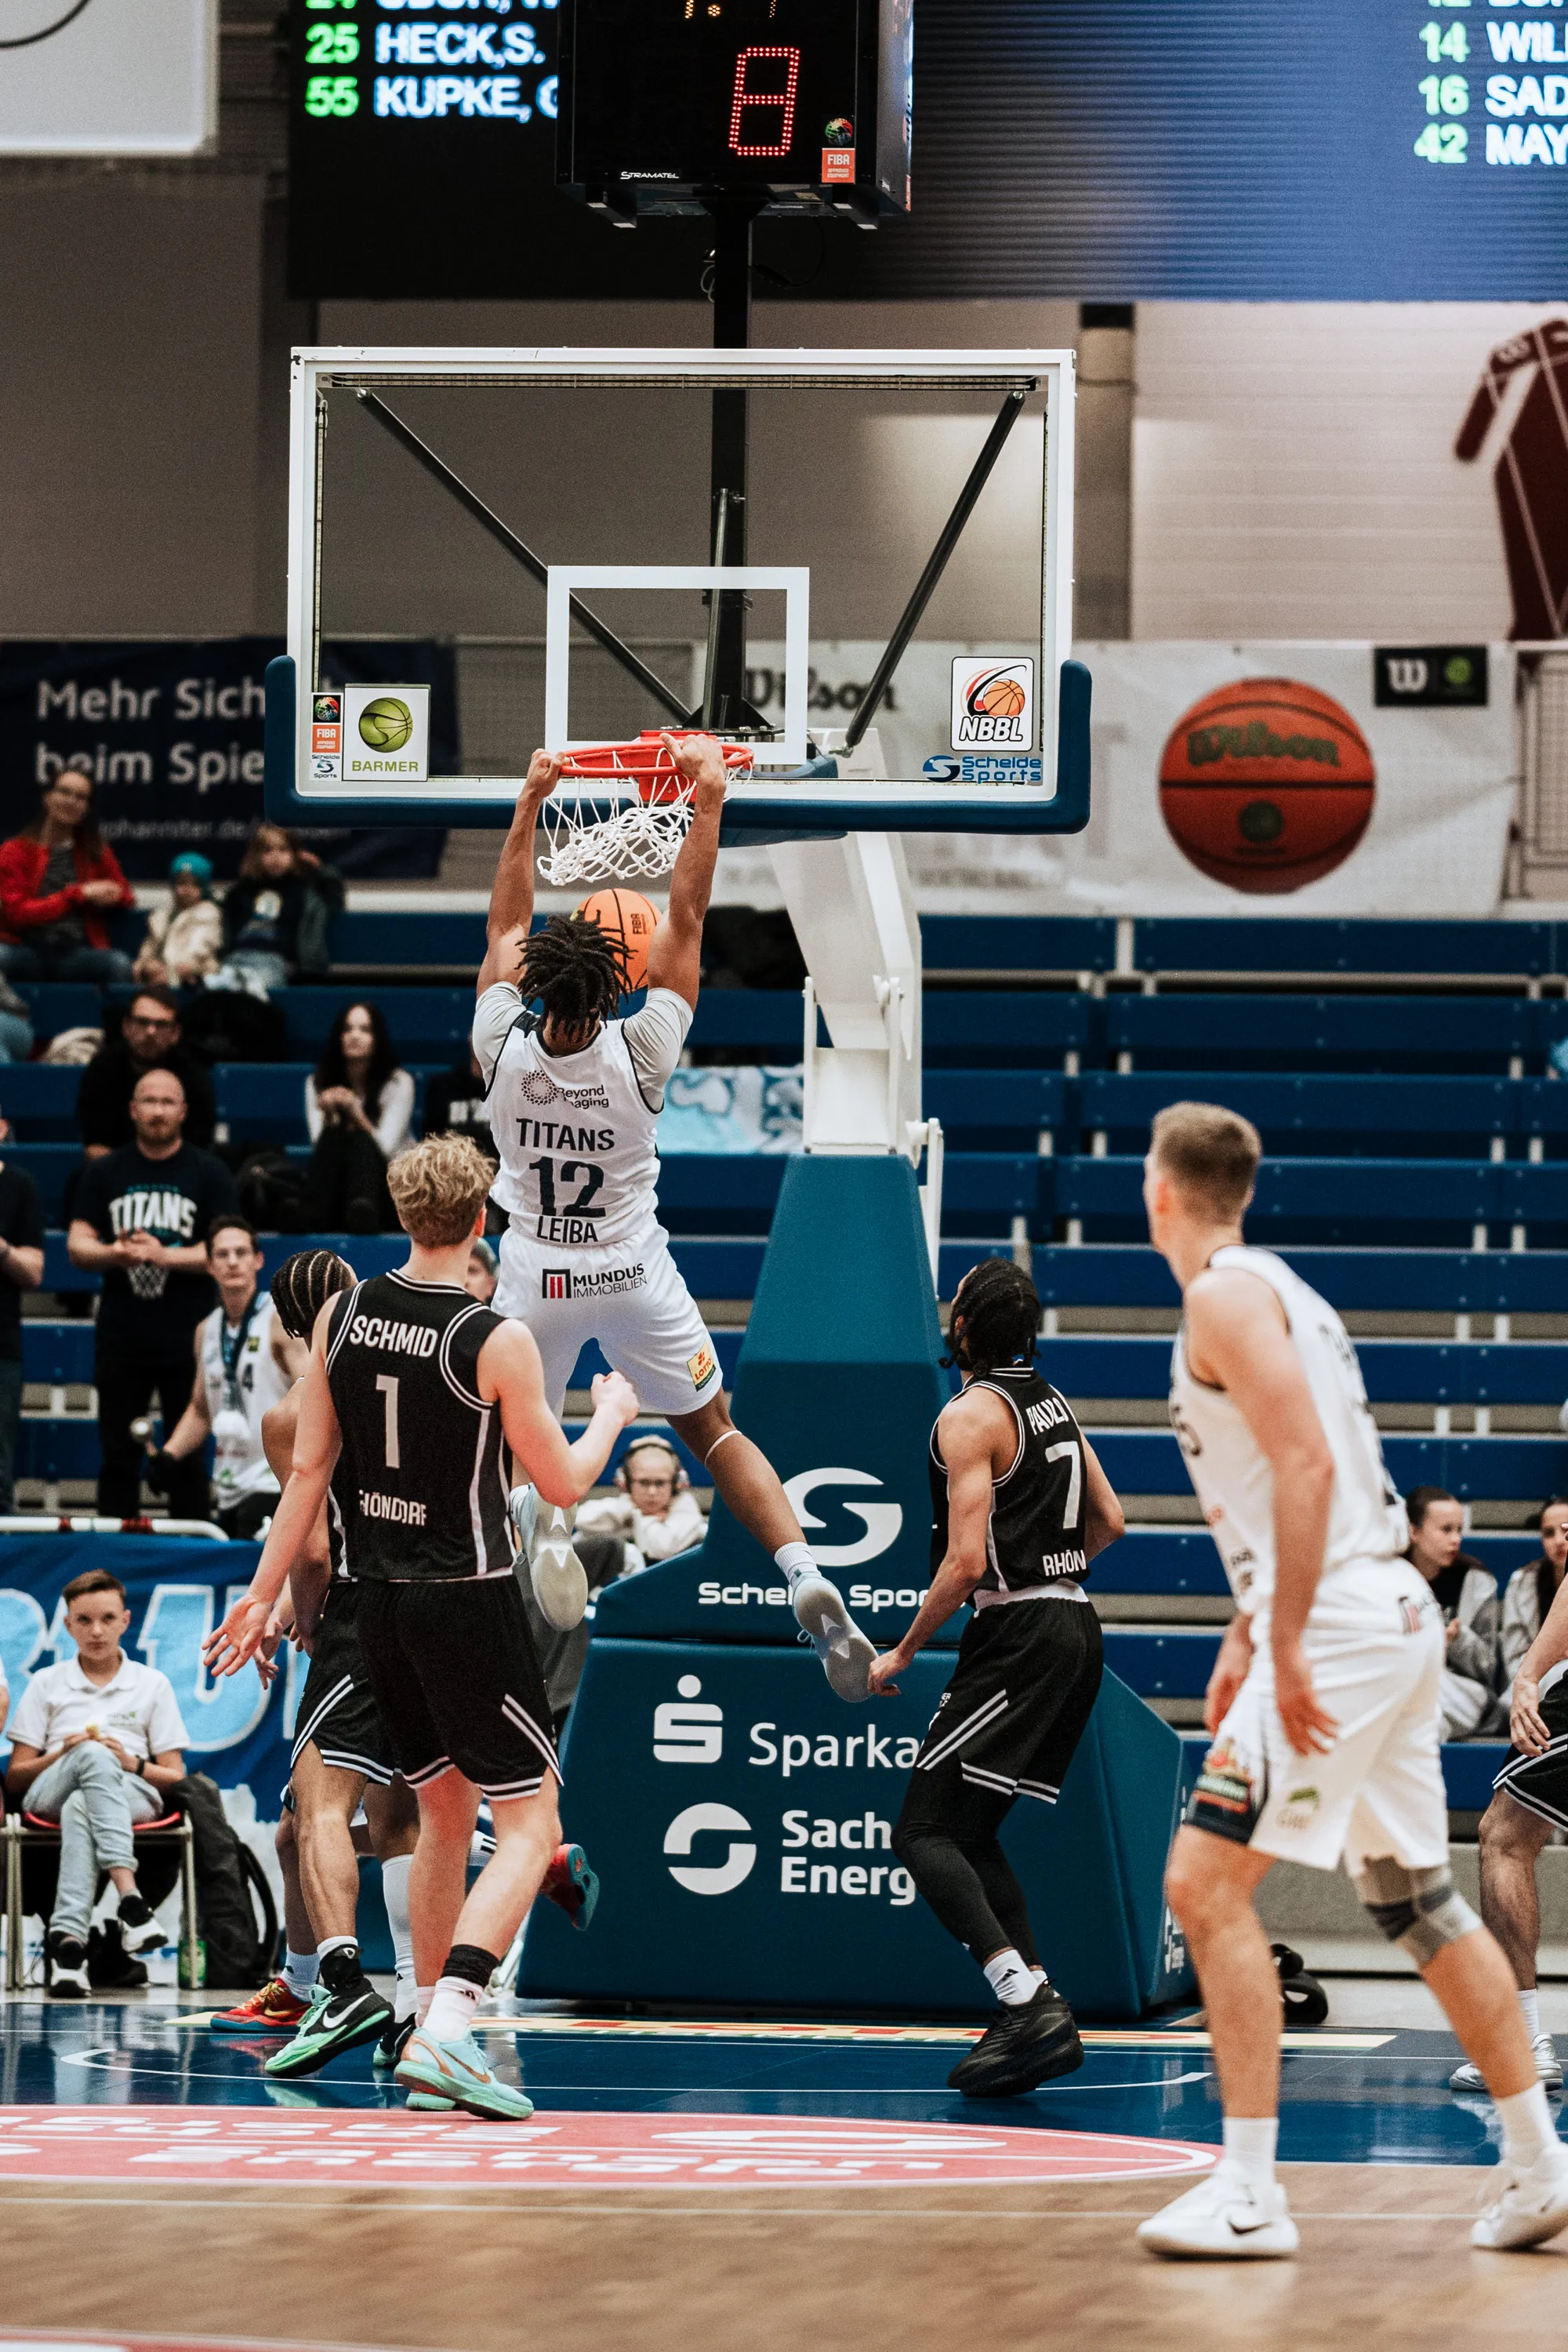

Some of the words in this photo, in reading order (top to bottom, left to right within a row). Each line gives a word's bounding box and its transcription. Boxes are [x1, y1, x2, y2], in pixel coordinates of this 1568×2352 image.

[306, 22, 360, 64] 25
[1419, 21, 1471, 63] 14
[1486, 21, 1568, 63] WIL
[305, 76, 359, 117] 55
[374, 75, 532, 123] KUPKE,
[728, 47, 800, 156] 8
[1418, 74, 1469, 115] 16
[1485, 74, 1568, 118] SAD
[827, 154, 850, 165] FIBA
[1414, 122, 1468, 163] 42
[620, 171, 680, 180] STRAMATEL
[38, 679, 160, 720] Mehr
[317, 728, 336, 739] FIBA
[959, 717, 1023, 742] NBBL
[352, 760, 419, 772] BARMER
[962, 756, 1042, 768] Schelde
[962, 769, 1042, 784] Sports
[564, 1098, 609, 1109] aging
[516, 1118, 615, 1152] TITANS
[529, 1156, 606, 1218] 12
[109, 1191, 198, 1239] TITANS
[536, 1216, 599, 1243] LEIBA
[573, 1263, 644, 1287] MUNDUS
[573, 1276, 648, 1298] IMMOBILIEN
[350, 1315, 438, 1357] SCHMID
[695, 1358, 712, 1381] LOTTO
[376, 1374, 400, 1468] 1
[1045, 1440, 1081, 1529] 7
[1043, 1549, 1087, 1577] RHÖN
[748, 1722, 924, 1777] Sparka
[782, 1809, 891, 1849] Sach
[780, 1856, 917, 1906] Energ
